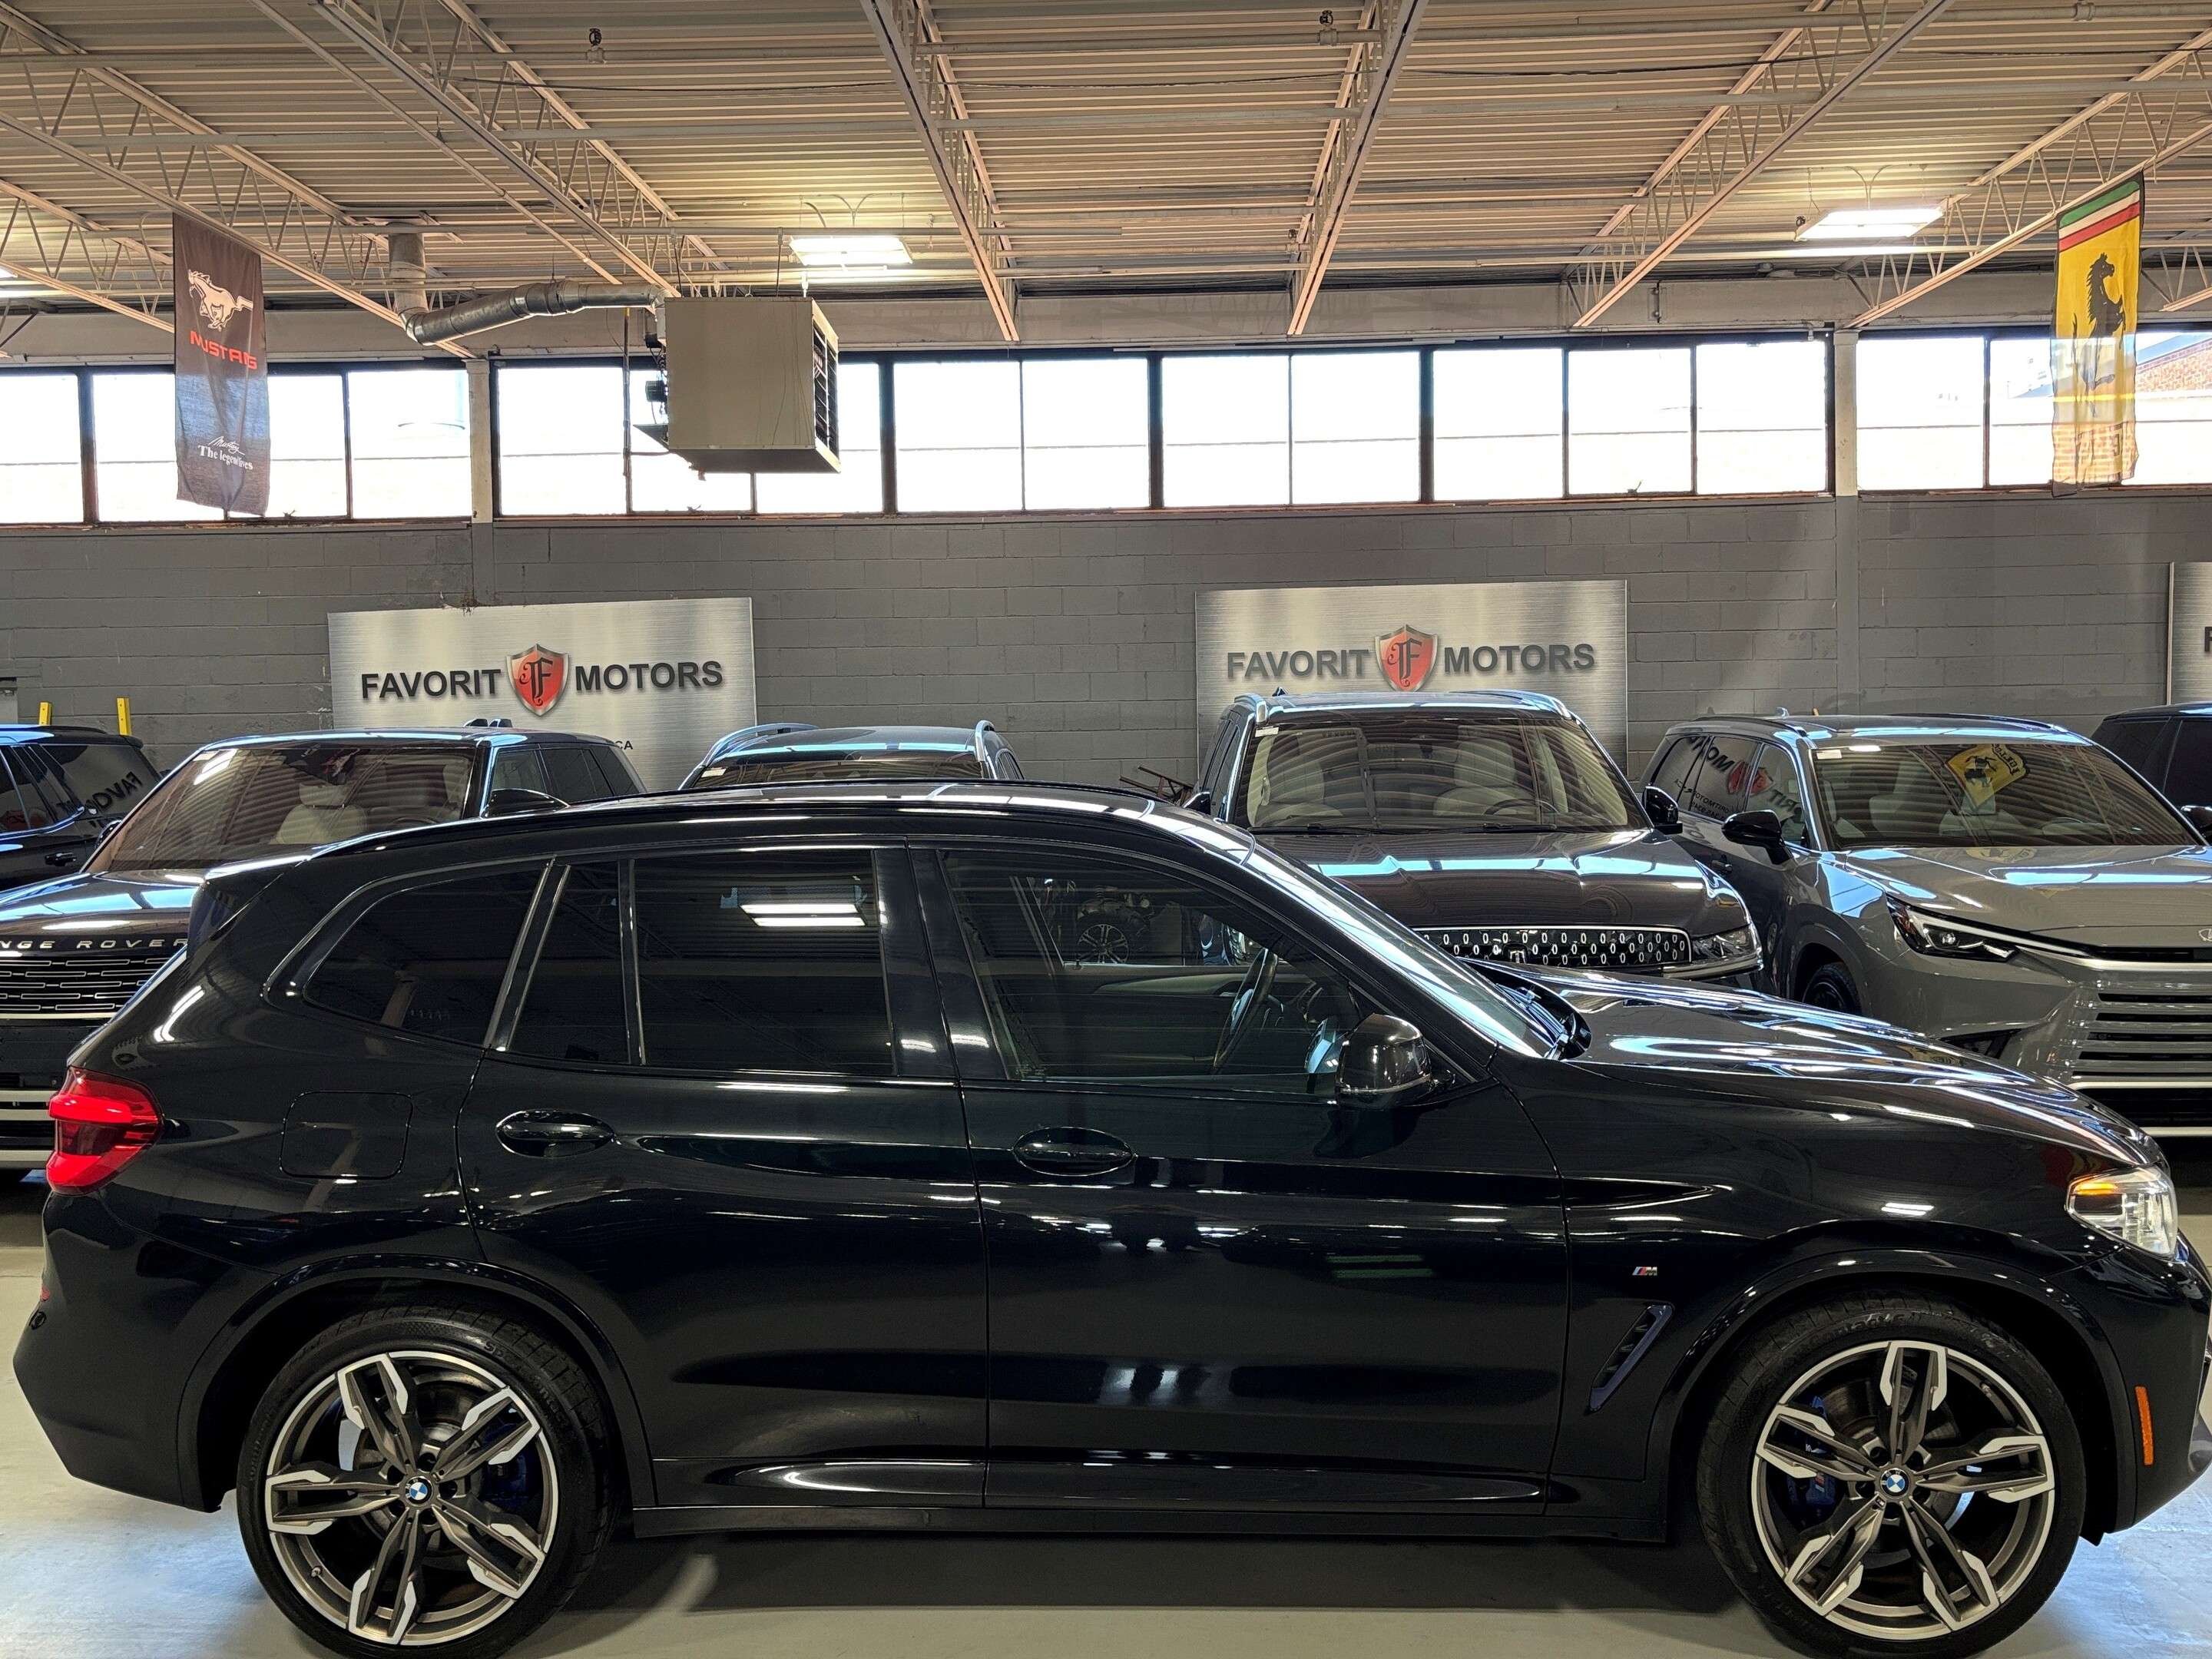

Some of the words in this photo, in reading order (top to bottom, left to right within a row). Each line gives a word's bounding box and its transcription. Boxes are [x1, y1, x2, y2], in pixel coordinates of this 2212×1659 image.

[198, 445, 218, 459] The
[1227, 648, 1369, 679] FAVORIT
[1444, 643, 1595, 674] MOTORS
[361, 668, 501, 699] FAVORIT
[575, 660, 723, 691] MOTORS
[77, 938, 188, 949] ROVER
